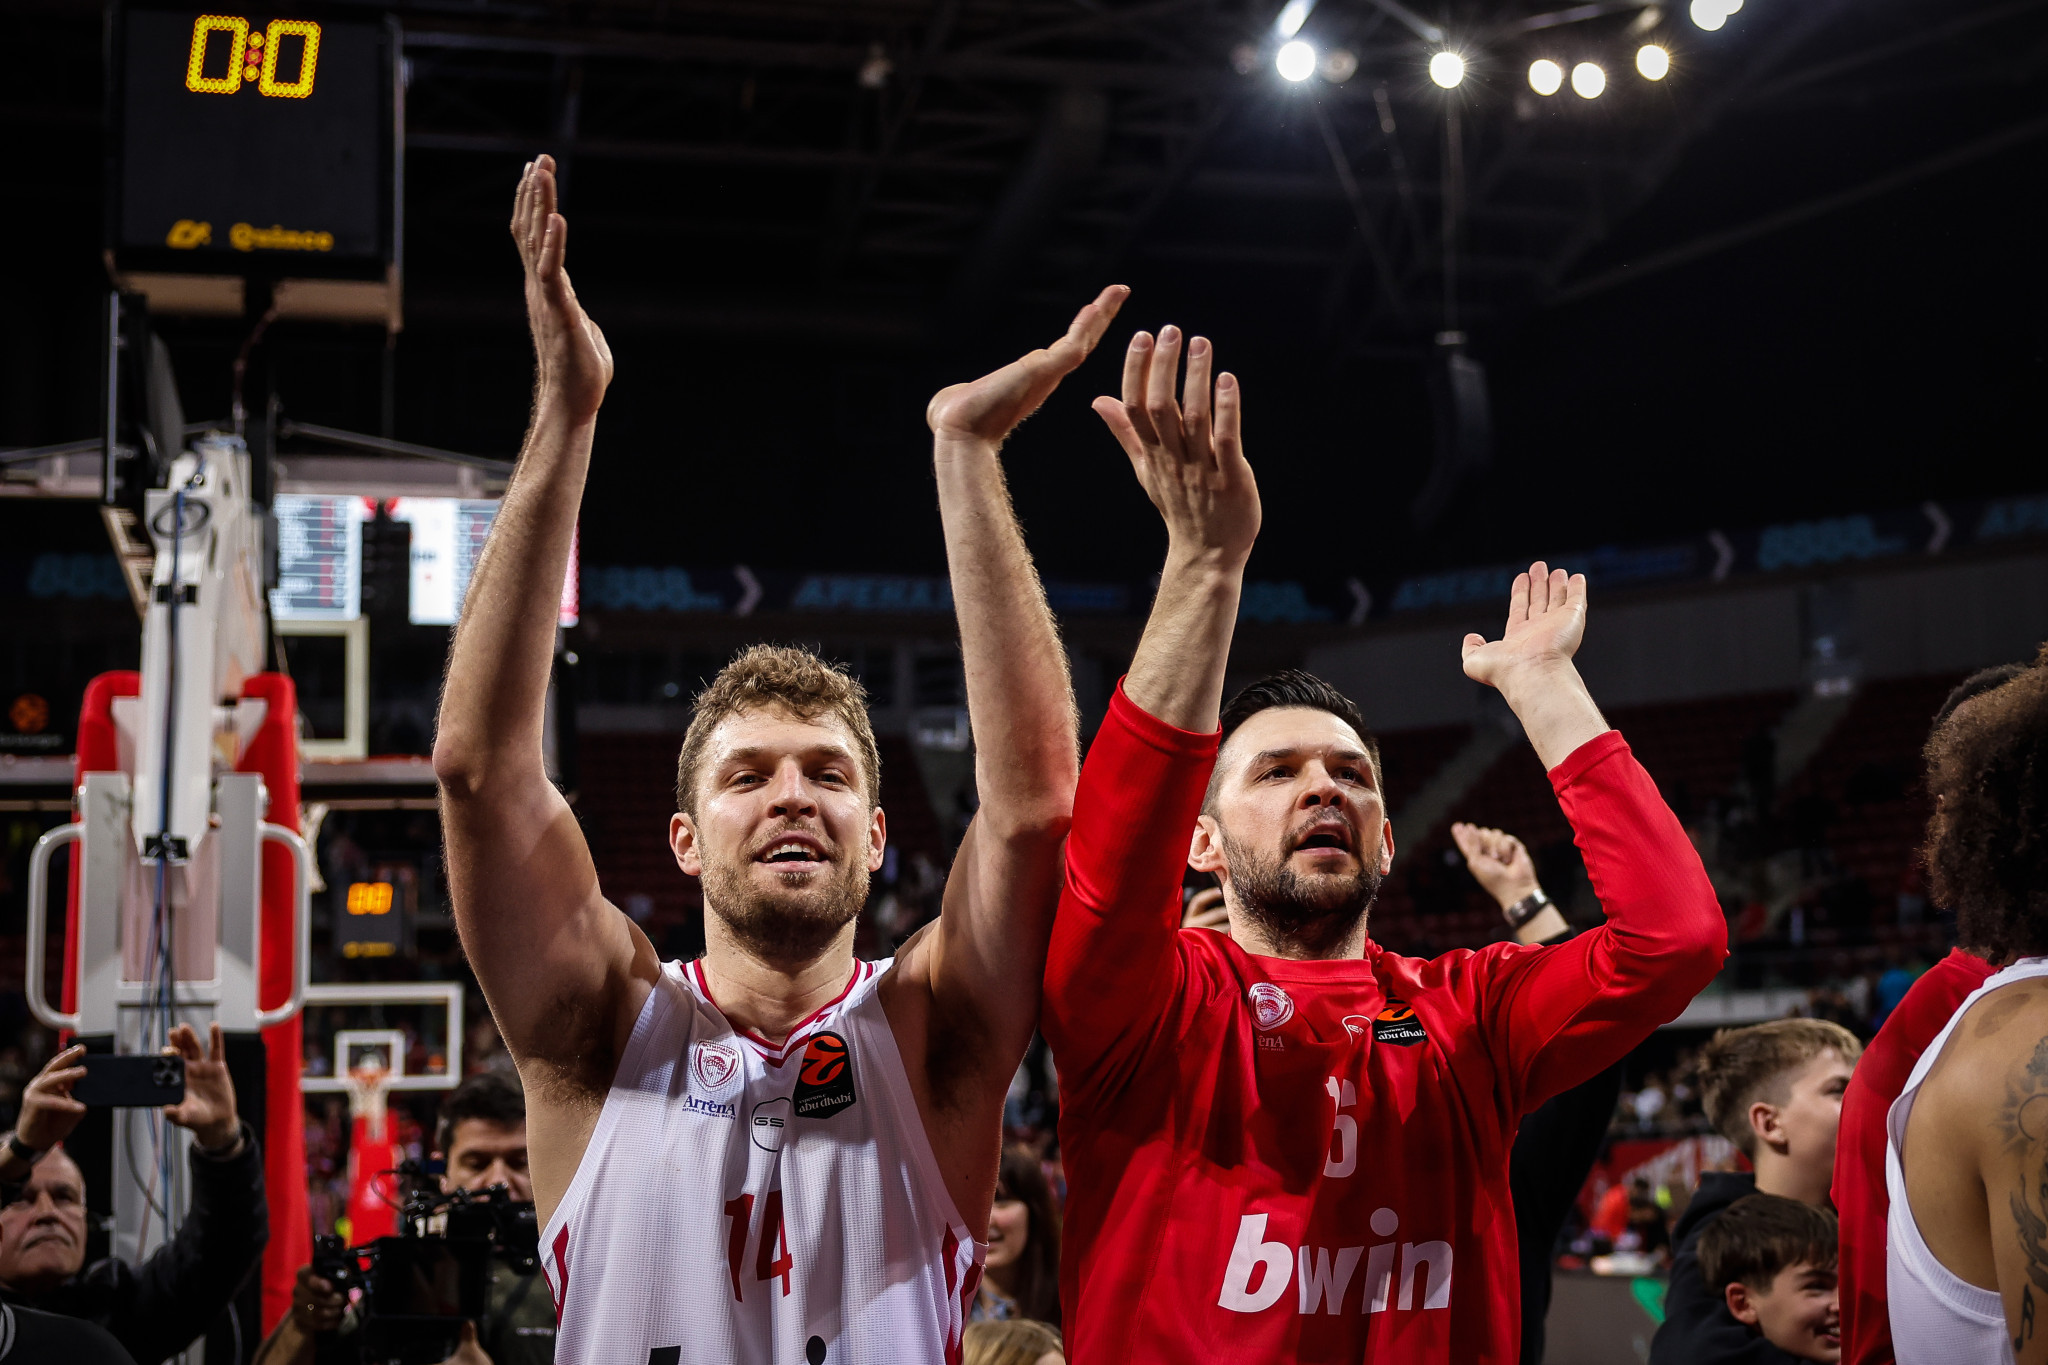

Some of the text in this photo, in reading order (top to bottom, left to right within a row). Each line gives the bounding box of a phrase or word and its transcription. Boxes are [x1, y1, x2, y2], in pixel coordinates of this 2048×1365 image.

[186, 14, 322, 99] 0:0
[1399, 1029, 1427, 1038] dhab
[754, 1116, 785, 1128] GS
[798, 1091, 852, 1113] abu dhabi
[724, 1189, 794, 1303] 14
[1217, 1207, 1454, 1316] bwin
